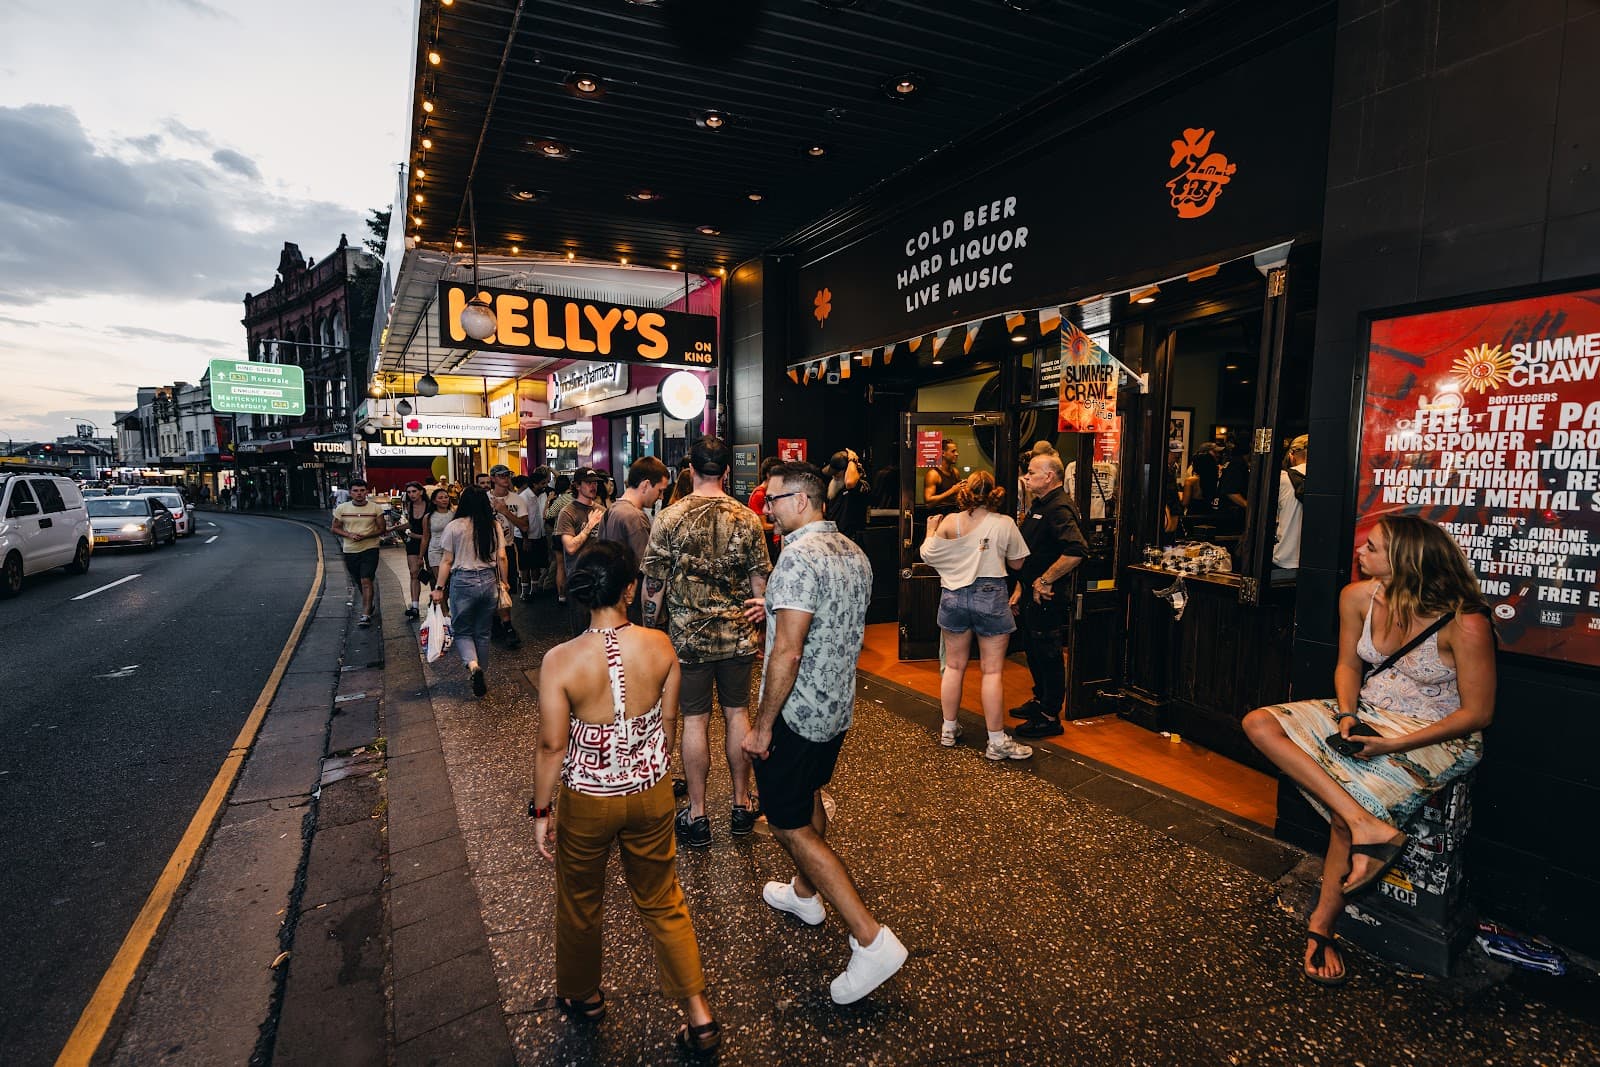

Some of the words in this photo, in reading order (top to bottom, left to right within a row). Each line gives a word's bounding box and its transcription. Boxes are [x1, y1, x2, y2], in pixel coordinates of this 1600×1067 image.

[905, 219, 955, 257] COLD
[963, 196, 1017, 231] BEER
[896, 254, 943, 290] HARD
[950, 226, 1029, 267] LIQUOR
[906, 283, 940, 313] LIVE
[947, 262, 1013, 298] MUSIC
[448, 287, 669, 360] KELLY'S
[694, 341, 712, 352] ON
[1511, 332, 1600, 366] SUMME
[684, 351, 712, 364] KING
[251, 375, 289, 385] Rockdale
[584, 361, 618, 391] pharmacy
[1065, 364, 1113, 384] SUMMER
[1508, 356, 1600, 387] CRAW
[217, 394, 268, 403] Marrickville
[1064, 382, 1113, 401] CRAWL
[1488, 392, 1559, 405] BOOTLEGGERS
[220, 401, 267, 411] Canterbury
[426, 422, 460, 430] priceline
[461, 423, 498, 432] pharmacy
[1414, 407, 1473, 433] FEEL
[1487, 403, 1546, 432] THE
[313, 442, 346, 453] UTURN
[1384, 431, 1525, 452] HORSEPOWER
[1440, 450, 1507, 470] PEACE
[1515, 449, 1600, 470] RITUAL
[1457, 469, 1539, 489] THIKHA
[1566, 470, 1600, 491] RE
[1382, 486, 1477, 507] NEGATIVE
[1484, 489, 1581, 511] MENTAL
[1482, 524, 1513, 538] JOB!
[1528, 527, 1589, 543] AIRLINE
[1499, 549, 1568, 567] THERAPY
[1509, 538, 1600, 557] SUPAHONEY
[1480, 560, 1533, 577] BETTER
[1537, 565, 1597, 584] HEALTH
[1478, 579, 1511, 597] ING
[1537, 585, 1582, 605] FREE
